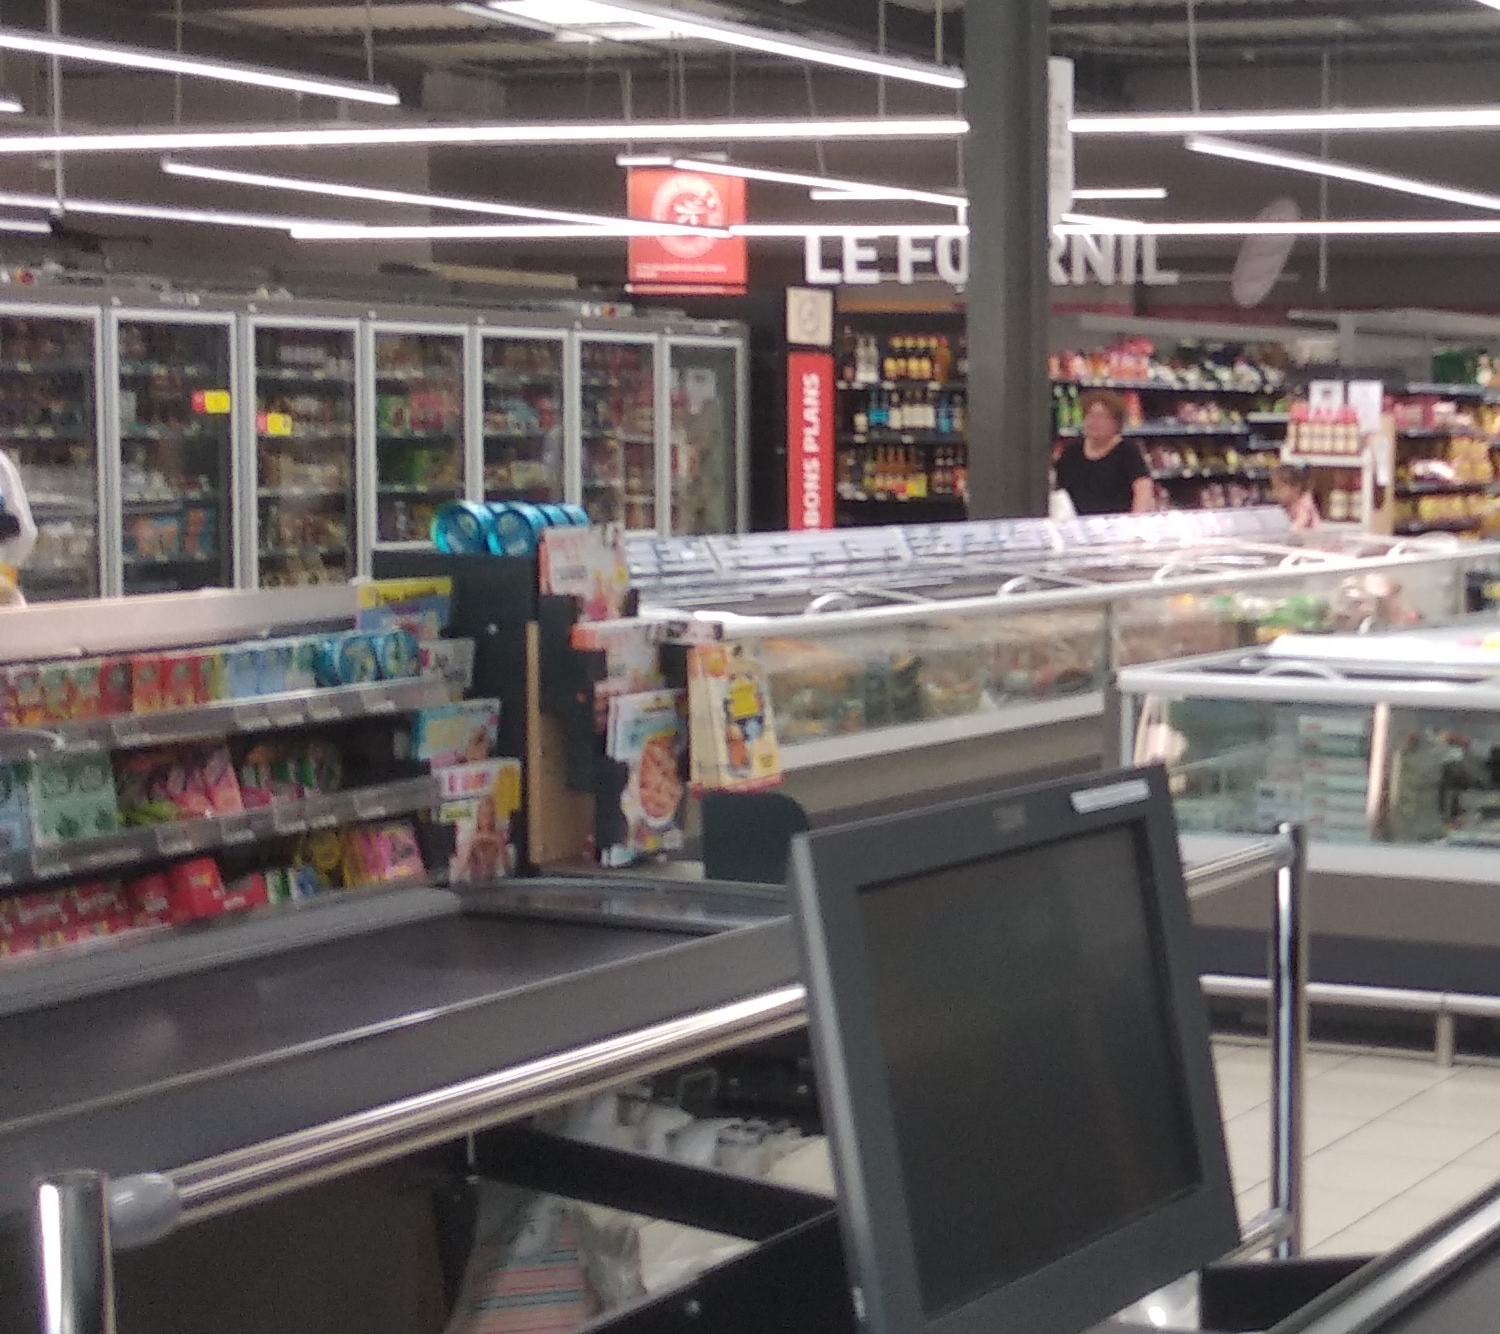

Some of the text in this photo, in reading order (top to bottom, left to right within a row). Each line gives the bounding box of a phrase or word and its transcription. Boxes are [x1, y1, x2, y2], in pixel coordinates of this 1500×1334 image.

[804, 230, 1180, 287] LE FORNIL
[802, 372, 822, 454] PLANS
